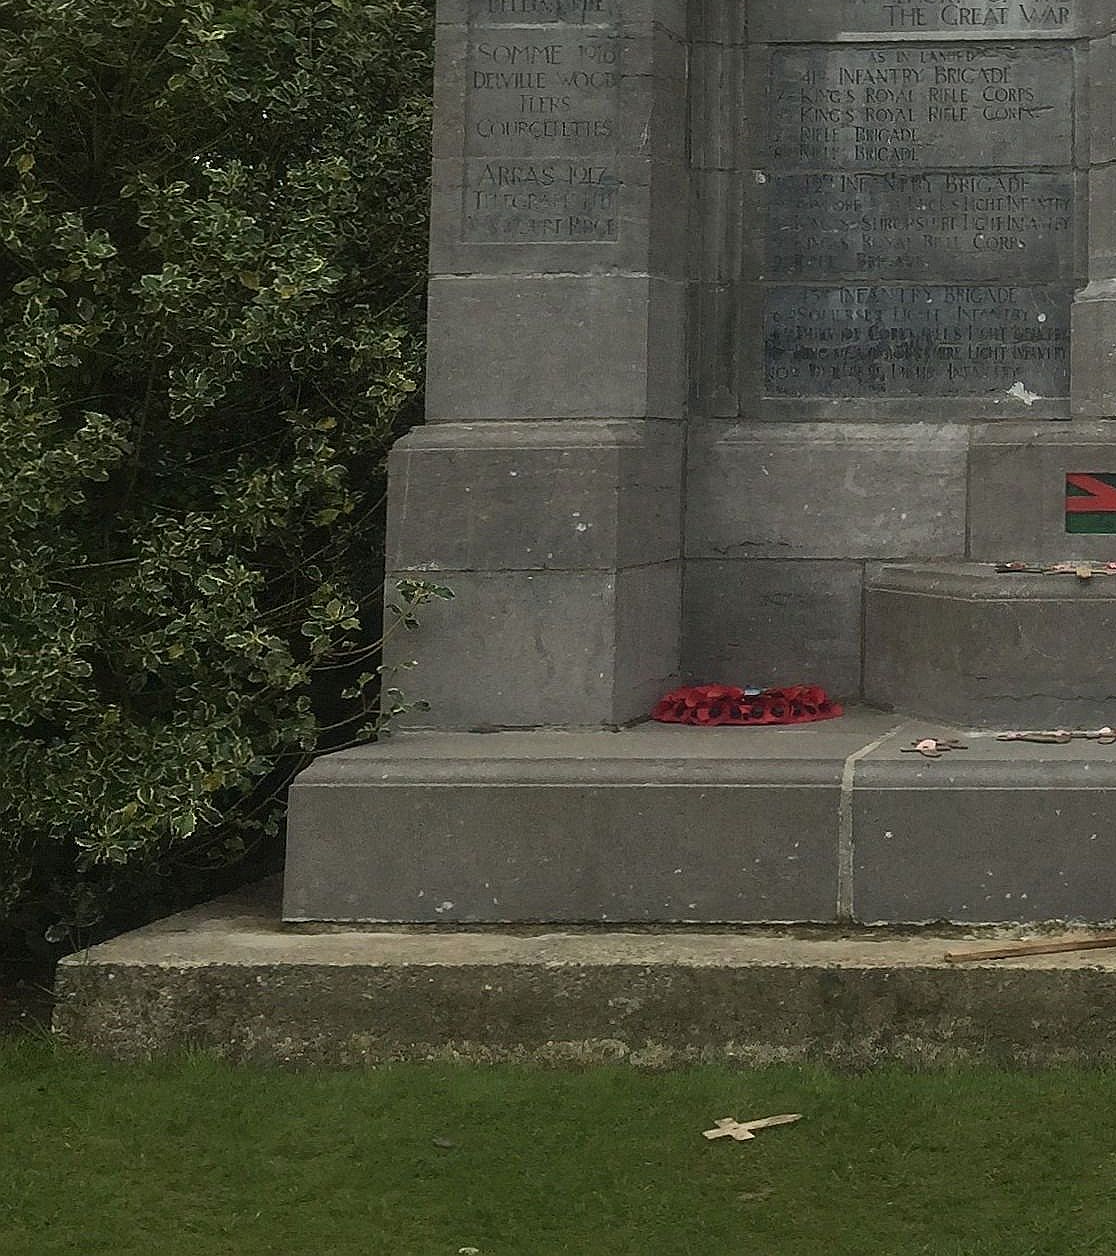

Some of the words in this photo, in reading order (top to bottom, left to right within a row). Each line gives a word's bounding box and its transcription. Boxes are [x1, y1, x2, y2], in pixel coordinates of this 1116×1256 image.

[883, 5, 929, 27] THE
[940, 4, 1009, 26] GREAT
[1019, 3, 1071, 25] WAR
[478, 45, 563, 65] SOMME
[839, 67, 925, 85] INFANTRY
[982, 86, 1035, 103] CORPS
[865, 107, 916, 123] ROYAL
[481, 164, 555, 186] ARRAS
